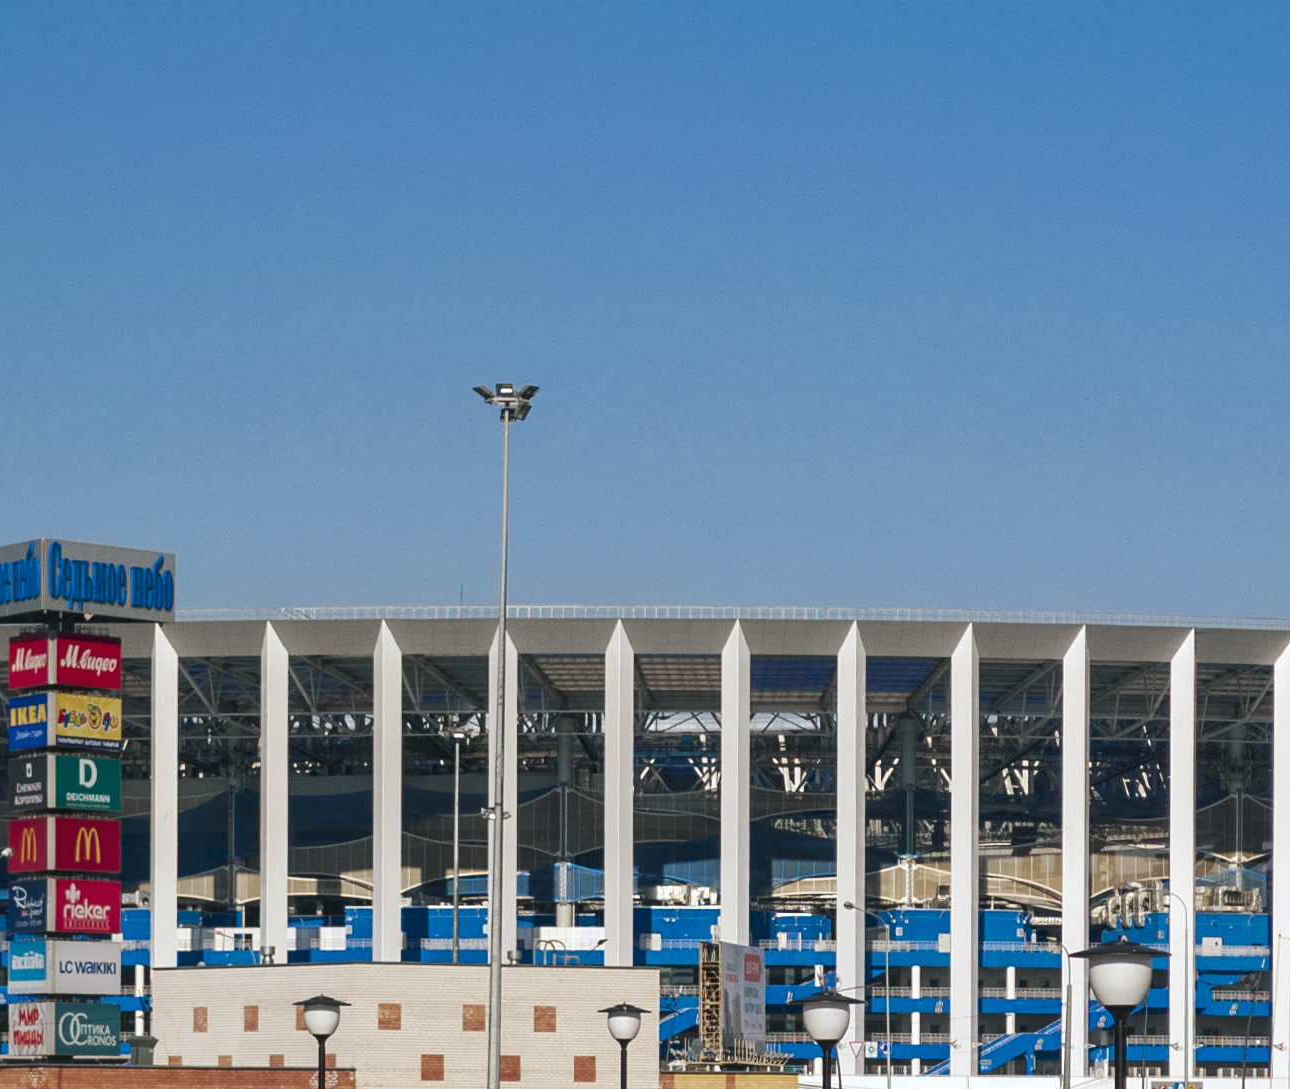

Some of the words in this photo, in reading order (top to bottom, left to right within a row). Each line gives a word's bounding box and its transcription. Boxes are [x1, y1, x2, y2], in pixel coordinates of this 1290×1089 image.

[48, 541, 126, 610] Седьмое
[130, 555, 175, 611] небо
[60, 644, 118, 676] М.видео
[10, 704, 47, 727] IKEA
[79, 758, 98, 788] D
[66, 792, 111, 804] DEICHMANN
[63, 899, 111, 919] rieker
[59, 960, 73, 974] LC
[18, 1007, 40, 1026] МИР
[13, 1028, 44, 1049] ПИЦЦЫ
